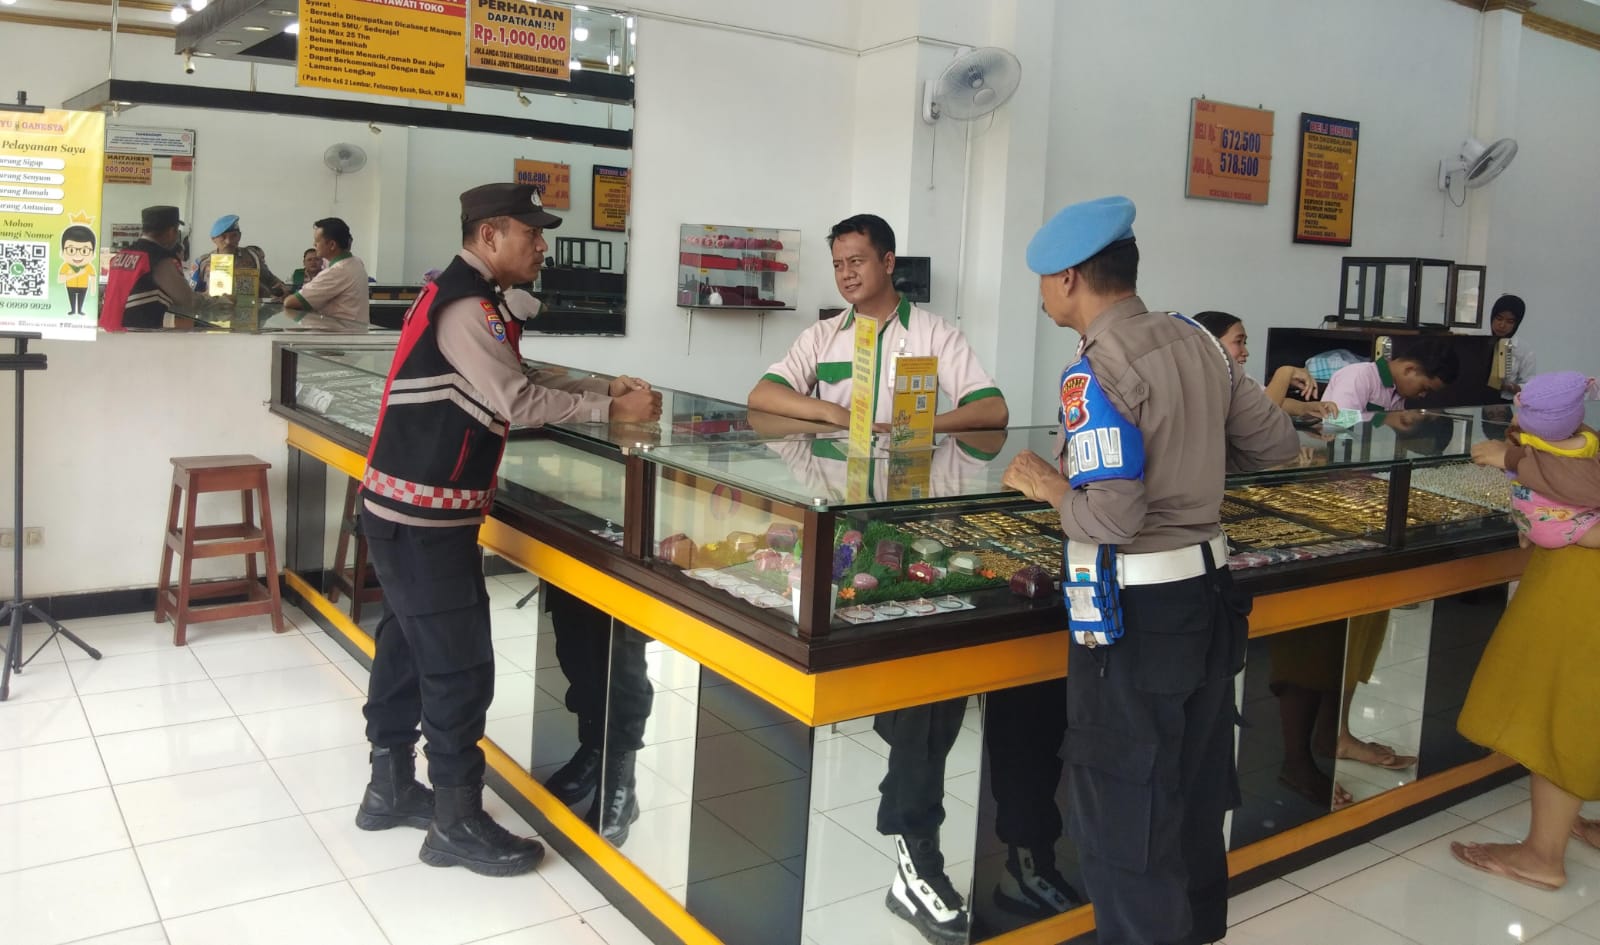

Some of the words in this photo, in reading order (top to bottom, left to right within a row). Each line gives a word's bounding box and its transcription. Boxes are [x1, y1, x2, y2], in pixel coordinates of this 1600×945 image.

[420, 2, 445, 13] TOKO
[478, 0, 564, 21] PERHATIAN
[310, 8, 344, 19] Bersedia
[346, 11, 393, 26] Ditempatkan
[395, 20, 428, 32] Dicabang
[430, 26, 462, 37] Manapun
[310, 18, 340, 27] Lulusan
[364, 25, 400, 36] Sederajat
[487, 12, 542, 28] DAPATKAN
[310, 26, 327, 35] Usia
[328, 29, 344, 37] Max
[346, 31, 356, 39] 25
[357, 33, 371, 41] Thn
[474, 23, 497, 46] Rp.
[499, 27, 567, 52] 1,000,000
[310, 35, 334, 44] Belum
[335, 38, 368, 49] Menikah
[310, 44, 354, 56] Penampilan
[412, 58, 427, 66] Dan
[428, 59, 445, 69] Jujur
[309, 53, 332, 63] Dapat
[334, 56, 389, 70] Berkomunikasi
[391, 63, 418, 74] Dengan
[420, 67, 436, 76] Baik
[309, 63, 342, 73] Lamaran
[344, 67, 376, 78] Lengkap
[22, 121, 65, 132] GANESYA
[2, 139, 58, 153] Pelayanan
[60, 144, 86, 155] Saya
[1222, 128, 1261, 153] 672.500
[23, 159, 44, 168] Sigap
[1220, 152, 1259, 177] 578.500
[23, 173, 51, 182] Senyum
[23, 188, 49, 196] Ramah
[22, 203, 54, 212] Antusias
[4, 219, 34, 228] Mohon
[25, 231, 54, 239] Nomor
